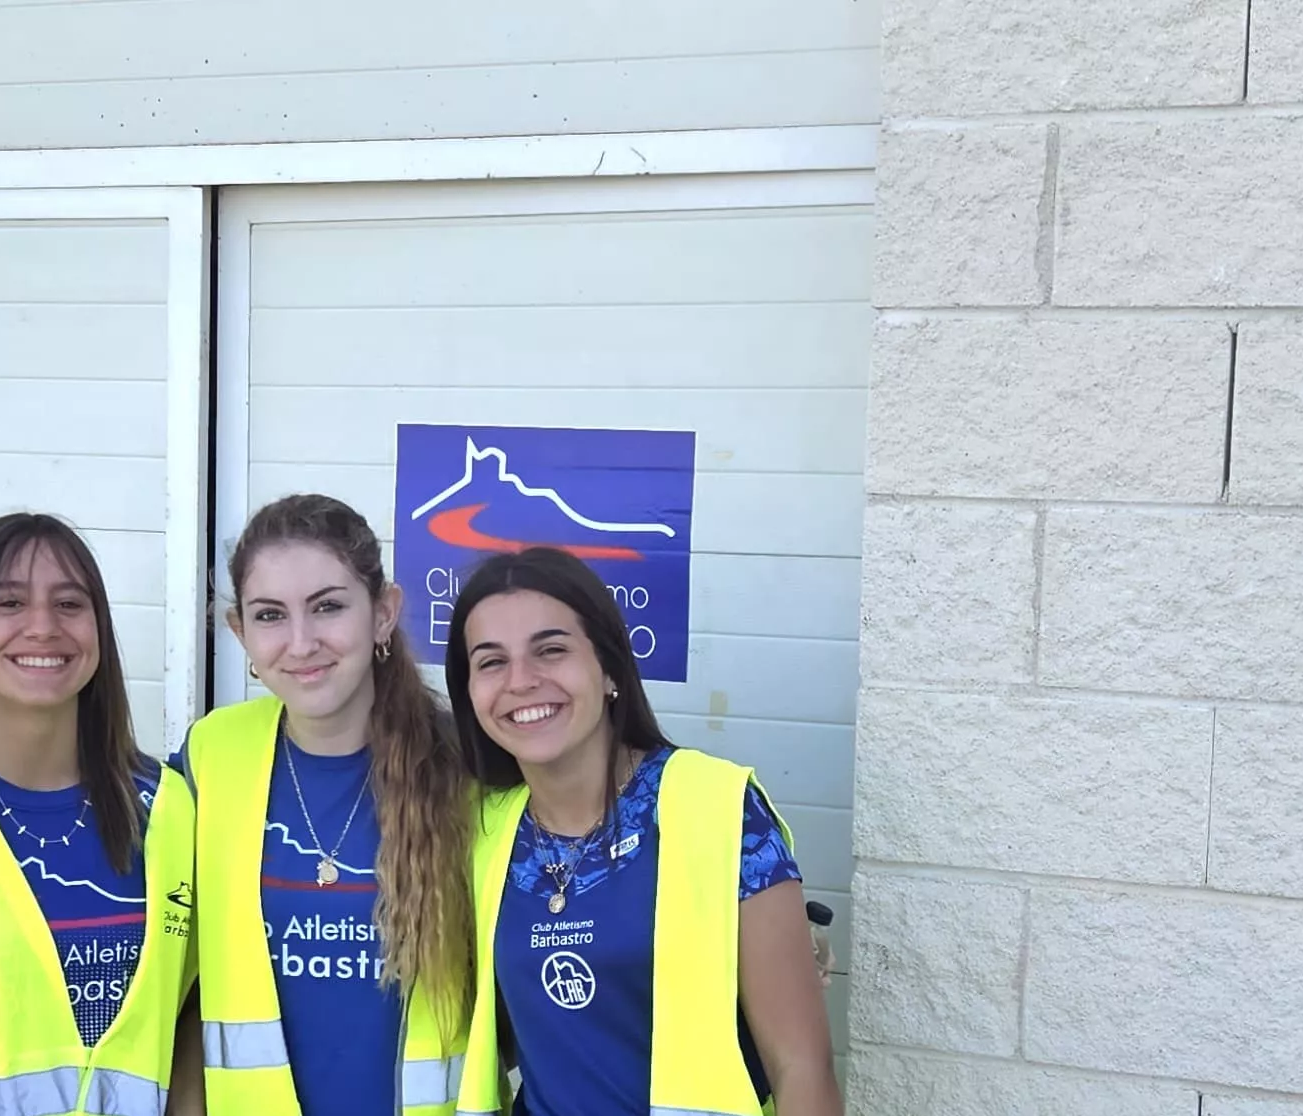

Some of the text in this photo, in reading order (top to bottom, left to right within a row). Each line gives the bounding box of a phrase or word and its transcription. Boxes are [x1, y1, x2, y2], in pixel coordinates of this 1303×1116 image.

[425, 567, 460, 598] Cl
[283, 914, 377, 941] Atletis
[531, 919, 594, 933] Club Atletismo
[64, 938, 139, 968] Atletis
[530, 932, 594, 949] Barbastro
